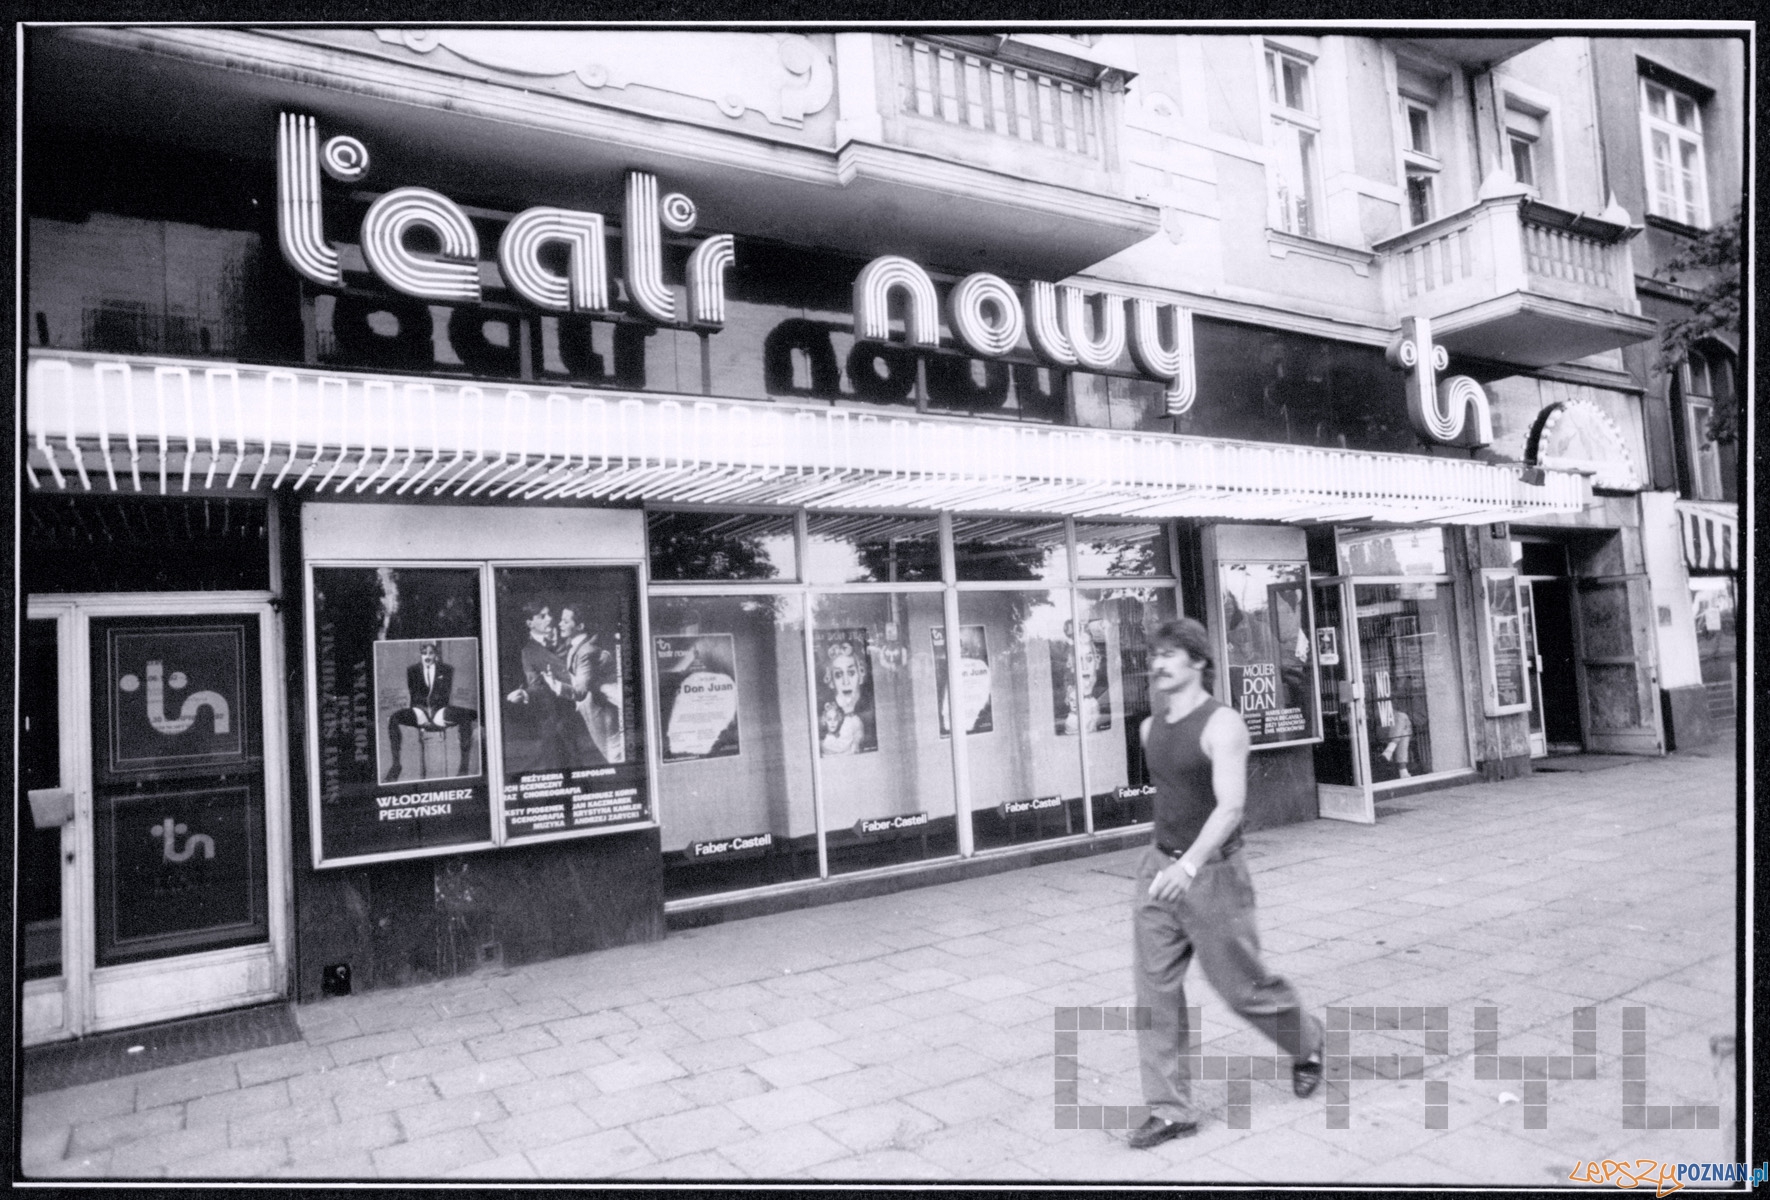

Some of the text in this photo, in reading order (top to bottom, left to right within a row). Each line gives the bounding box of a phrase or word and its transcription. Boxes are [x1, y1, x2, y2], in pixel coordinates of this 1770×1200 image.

[277, 110, 1196, 417] teatr nowy
[684, 682, 733, 694] Don Juan
[1243, 676, 1276, 695] DON
[1375, 671, 1391, 698] NO
[1240, 692, 1276, 715] JUAN
[1377, 700, 1396, 728] WA
[519, 781, 563, 791] SCENICZNY
[521, 772, 564, 783] REŻYSERIA
[376, 788, 472, 807] WŁODZIMIERZ
[523, 787, 581, 799] CHOREOGRAFIA
[1118, 784, 1157, 798] Faber-Cas
[379, 803, 451, 821] PERZYŃSKI
[1005, 796, 1061, 813] Faber-Castell
[511, 812, 565, 824] SCENOGRAFIA
[533, 820, 565, 830] MUZYKA
[862, 813, 927, 833] Faber-Castell
[695, 833, 772, 856] Faber-Castell
